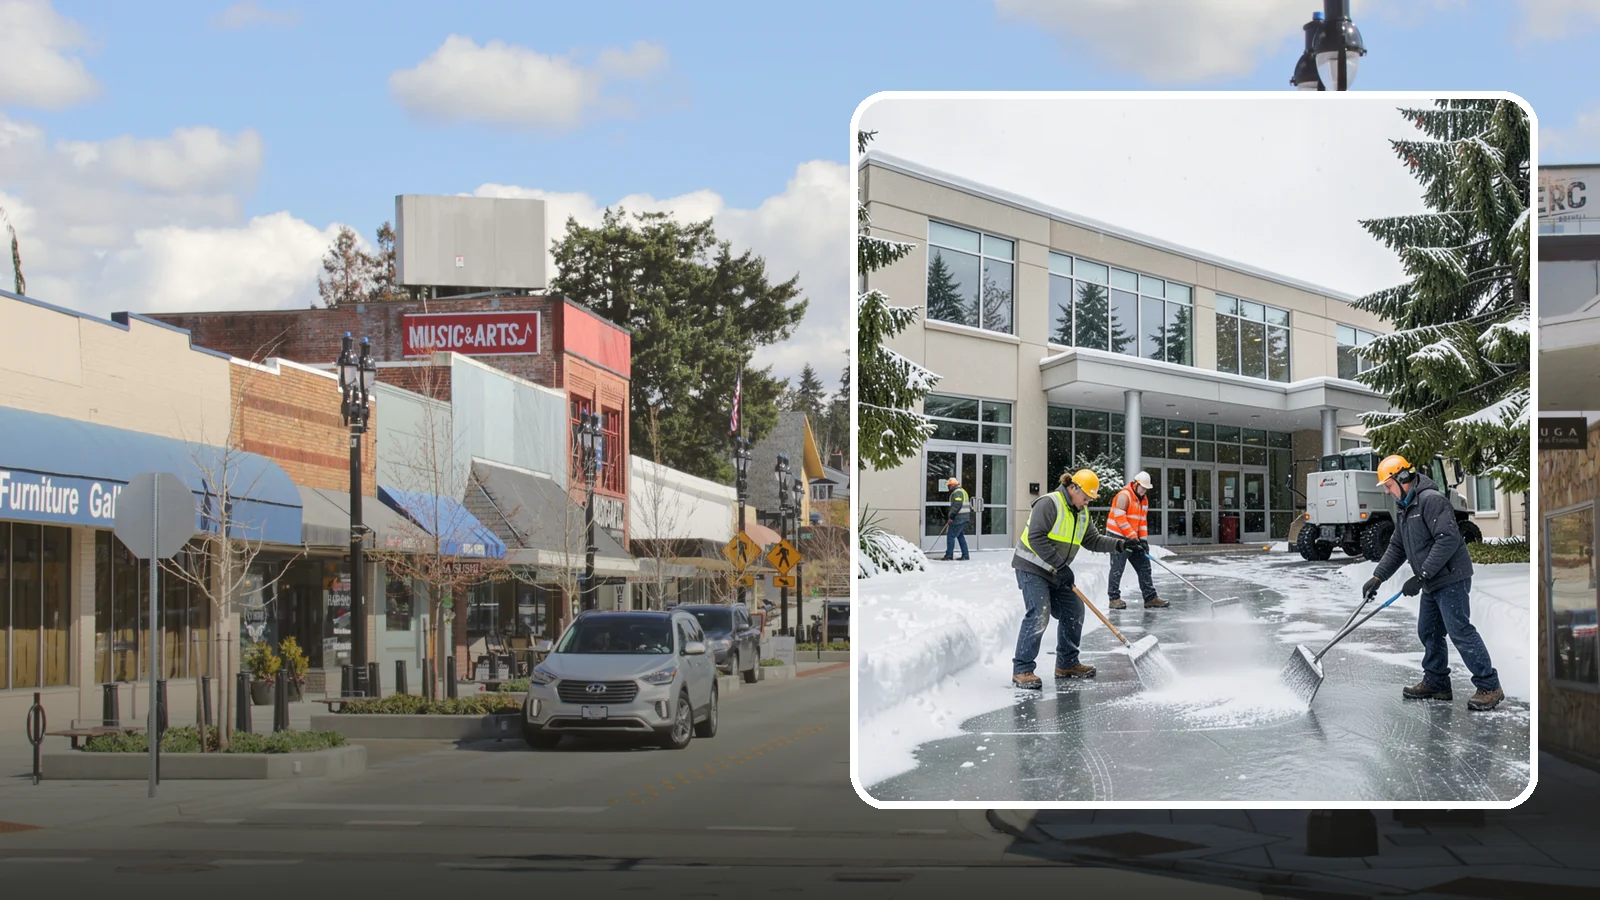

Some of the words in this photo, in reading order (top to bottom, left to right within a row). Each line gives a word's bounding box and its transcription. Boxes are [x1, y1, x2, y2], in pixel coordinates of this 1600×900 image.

[1540, 428, 1577, 436] UGA
[0, 472, 79, 515] Furniture
[453, 563, 479, 574] SUSHI
